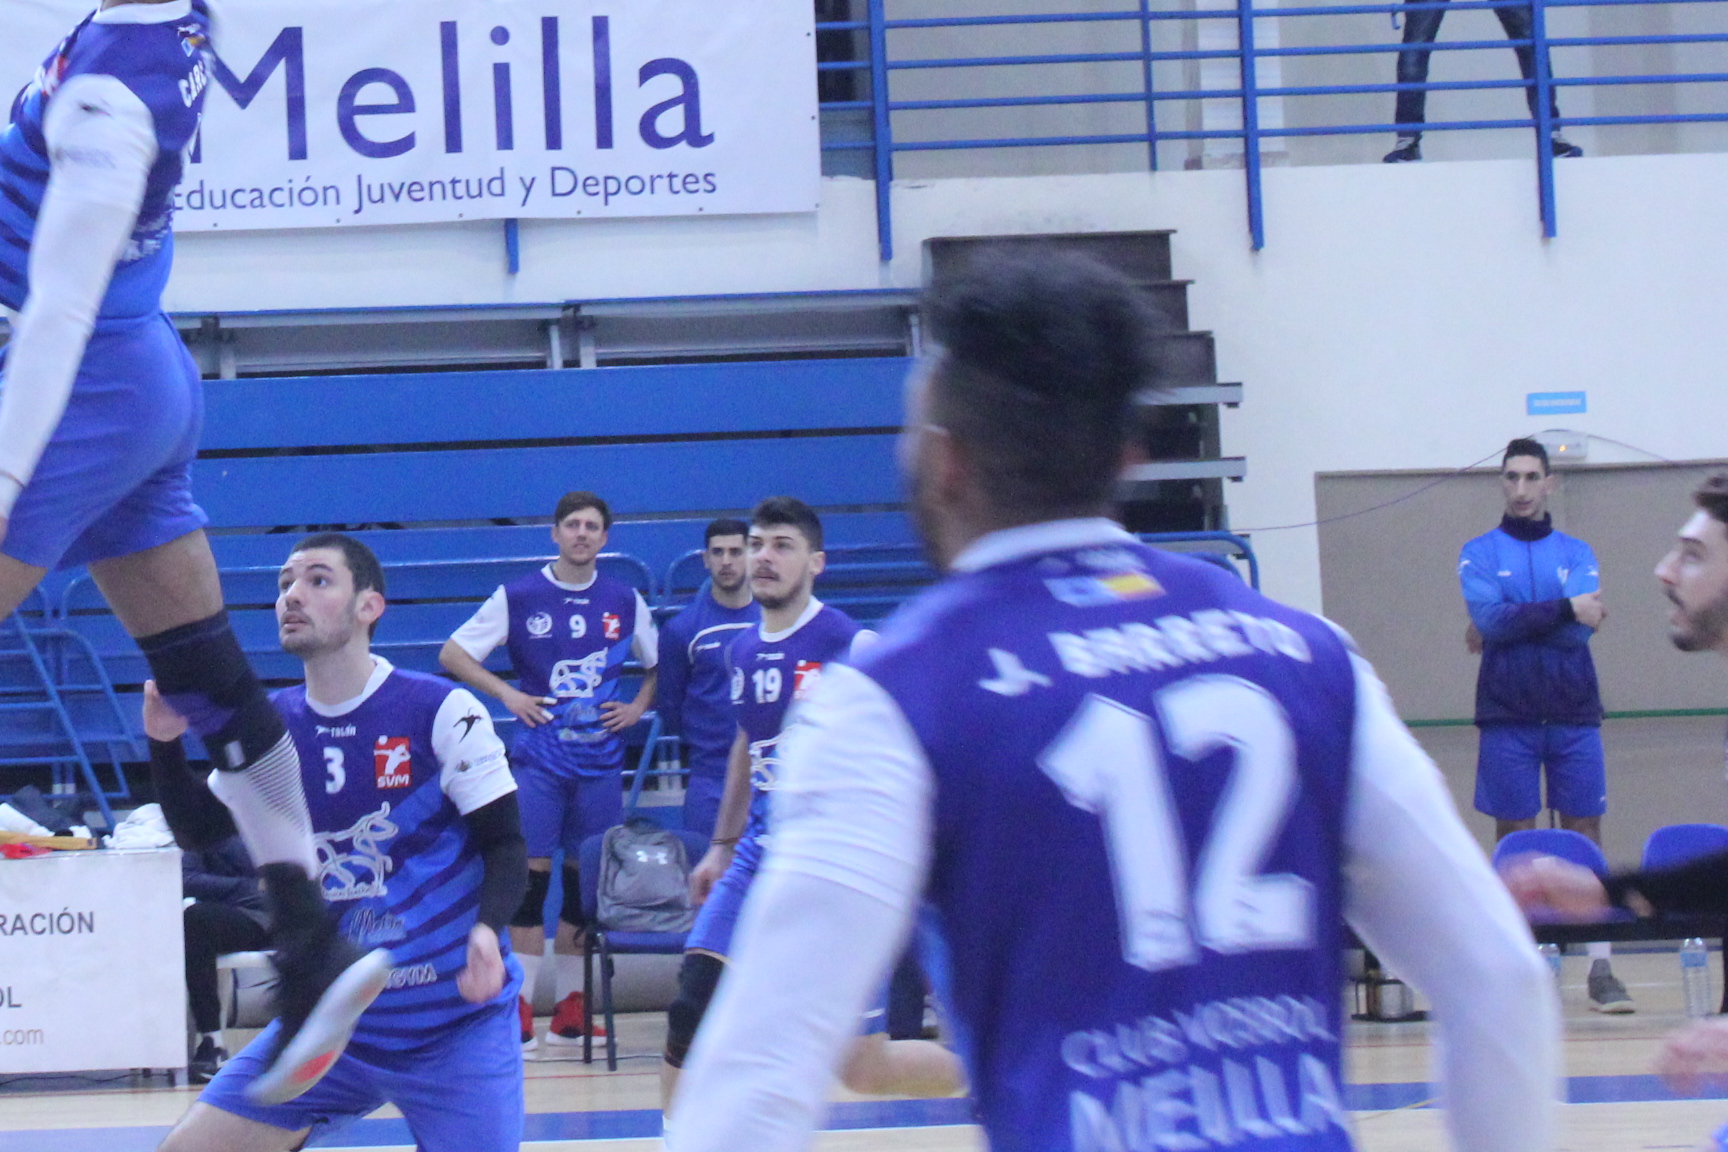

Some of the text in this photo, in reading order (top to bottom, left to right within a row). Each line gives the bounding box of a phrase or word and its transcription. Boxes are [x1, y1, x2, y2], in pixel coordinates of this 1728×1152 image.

[188, 14, 716, 164] Melilla
[353, 166, 506, 214] Juventud
[518, 175, 537, 207] y
[550, 166, 718, 206] Deportes
[568, 613, 587, 639] 9
[751, 667, 782, 704] 19
[323, 746, 347, 795] 3
[376, 773, 411, 788] SVM
[1035, 674, 1317, 972] 12
